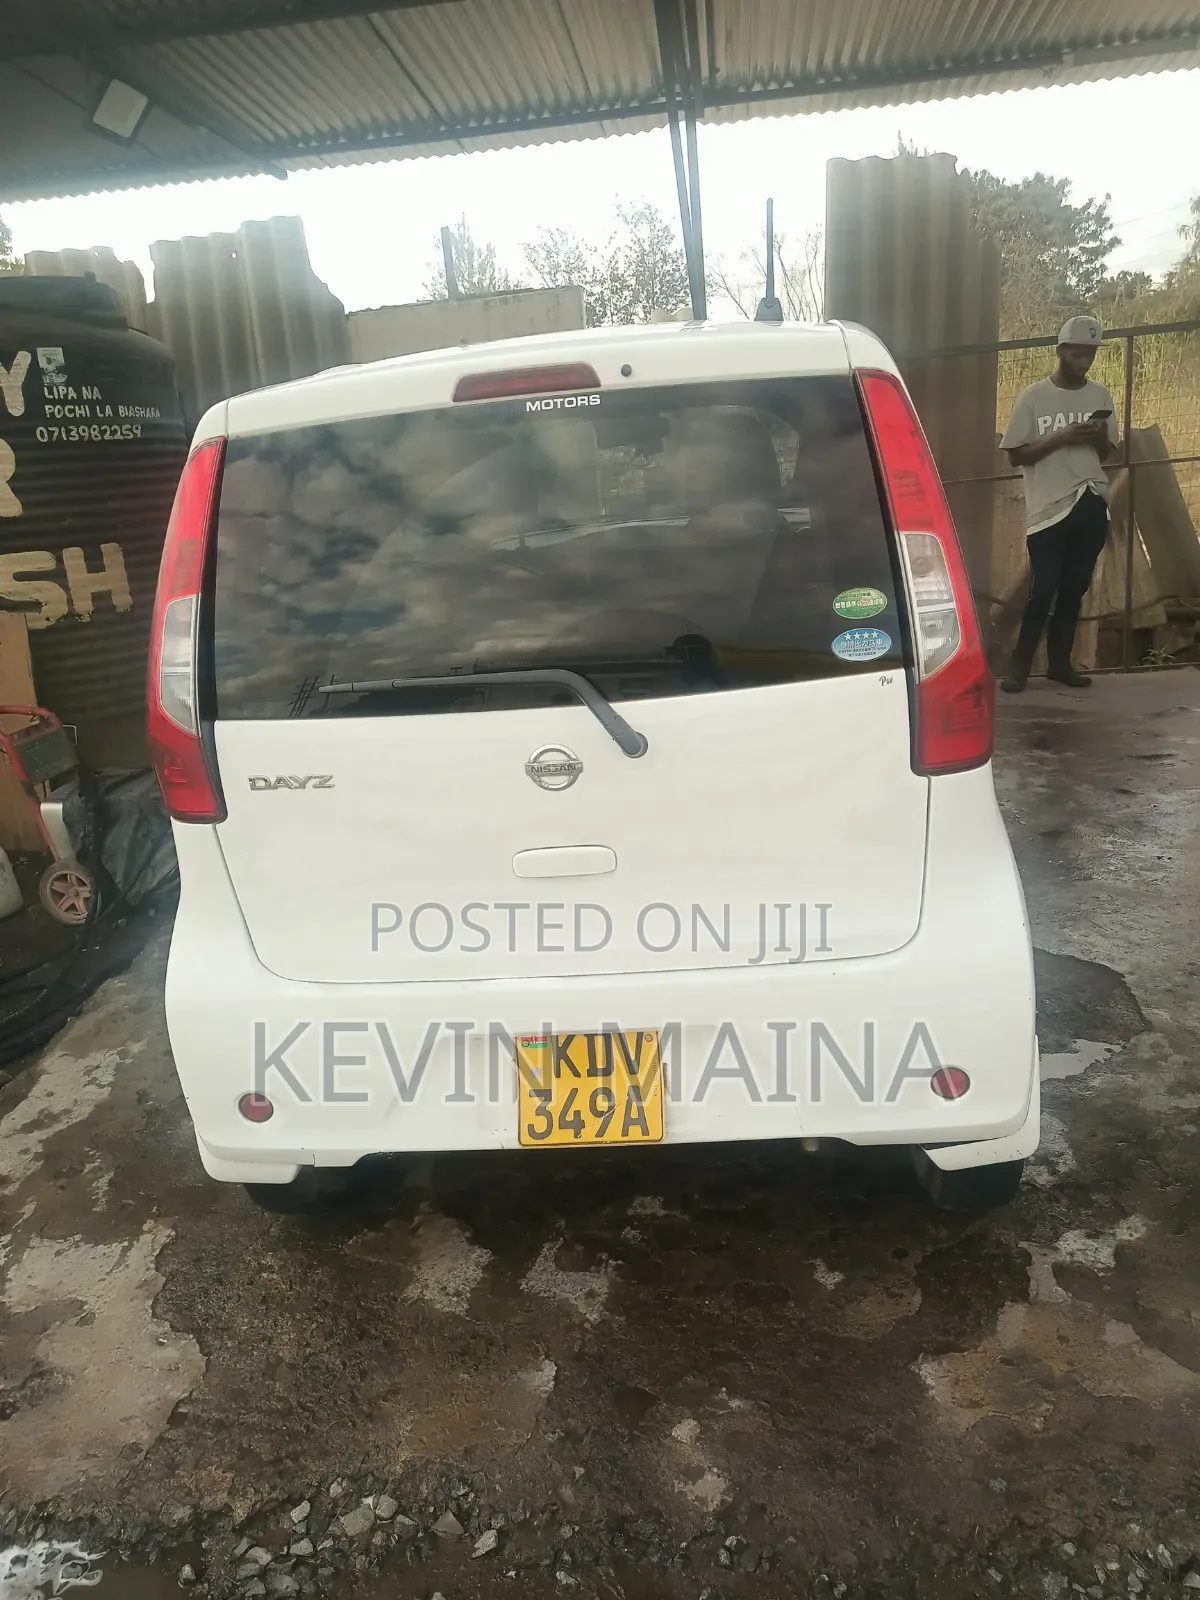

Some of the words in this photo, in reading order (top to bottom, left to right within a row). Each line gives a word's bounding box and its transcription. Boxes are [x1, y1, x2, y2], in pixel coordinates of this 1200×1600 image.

[44, 386, 77, 400] LIPA
[82, 386, 101, 400] NA
[45, 404, 90, 419] POCHI
[96, 405, 113, 417] LA
[118, 405, 161, 419] BIASHARA
[526, 394, 601, 412] MOTORS
[36, 424, 142, 443] 0713982259
[530, 763, 576, 773] NISSAN
[248, 774, 335, 791] DAYZ
[550, 1031, 645, 1079] KDV
[527, 1085, 650, 1141] 349A
